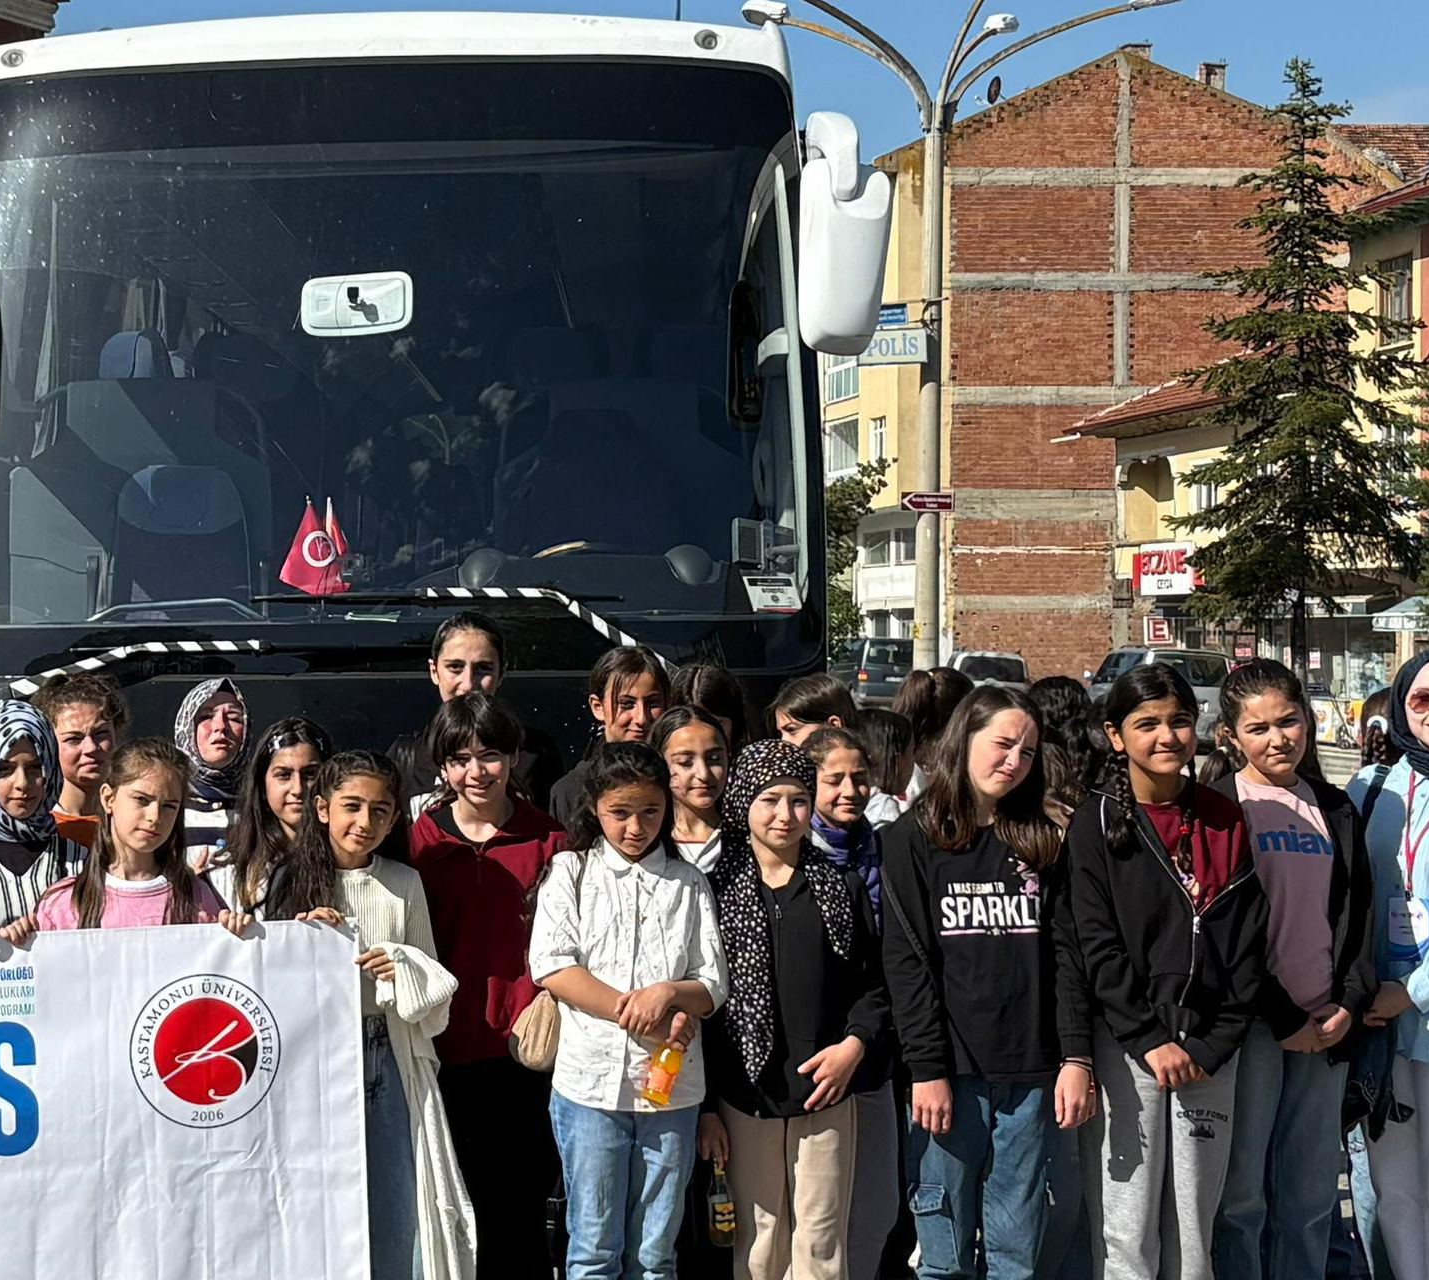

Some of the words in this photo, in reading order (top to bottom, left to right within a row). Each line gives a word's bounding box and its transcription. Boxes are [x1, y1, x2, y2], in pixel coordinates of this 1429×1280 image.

[866, 333, 919, 357] POLİS
[137, 982, 194, 1080] KASTAMONU
[201, 978, 274, 1073] ÜNİVERSİTESİ
[191, 1109, 224, 1122] 2006
